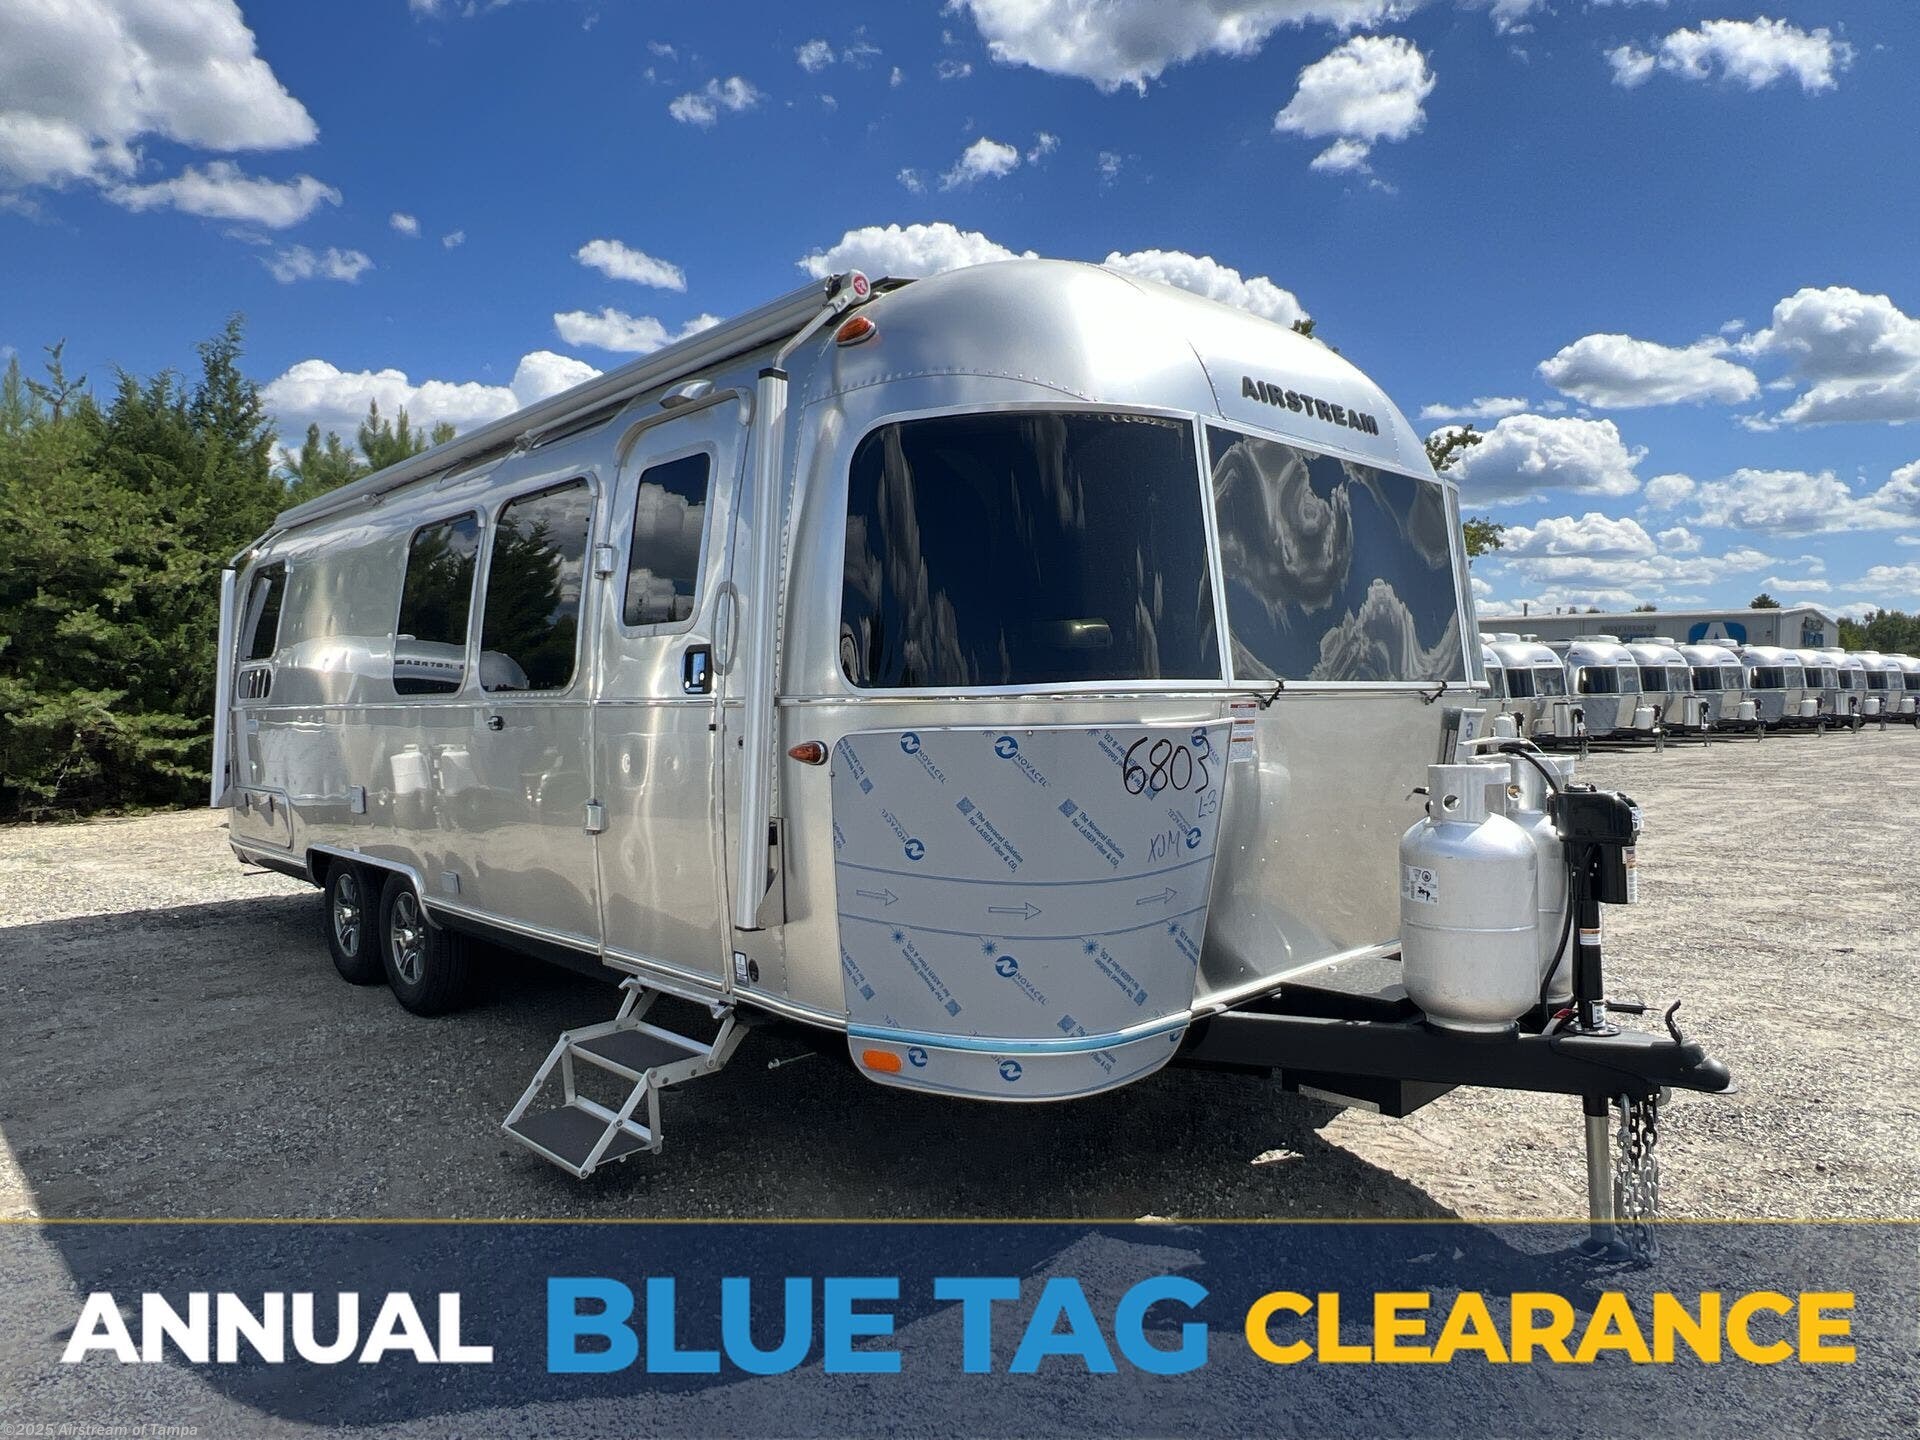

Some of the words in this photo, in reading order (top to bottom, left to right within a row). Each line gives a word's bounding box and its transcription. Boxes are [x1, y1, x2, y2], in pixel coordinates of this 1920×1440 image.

[1242, 375, 1379, 436] AIRSTREAM
[917, 749, 947, 784] NOVACEL
[1014, 752, 1048, 788] NOVACEL
[1122, 735, 1210, 795] 6803
[1014, 971, 1047, 1005] NOVACEL
